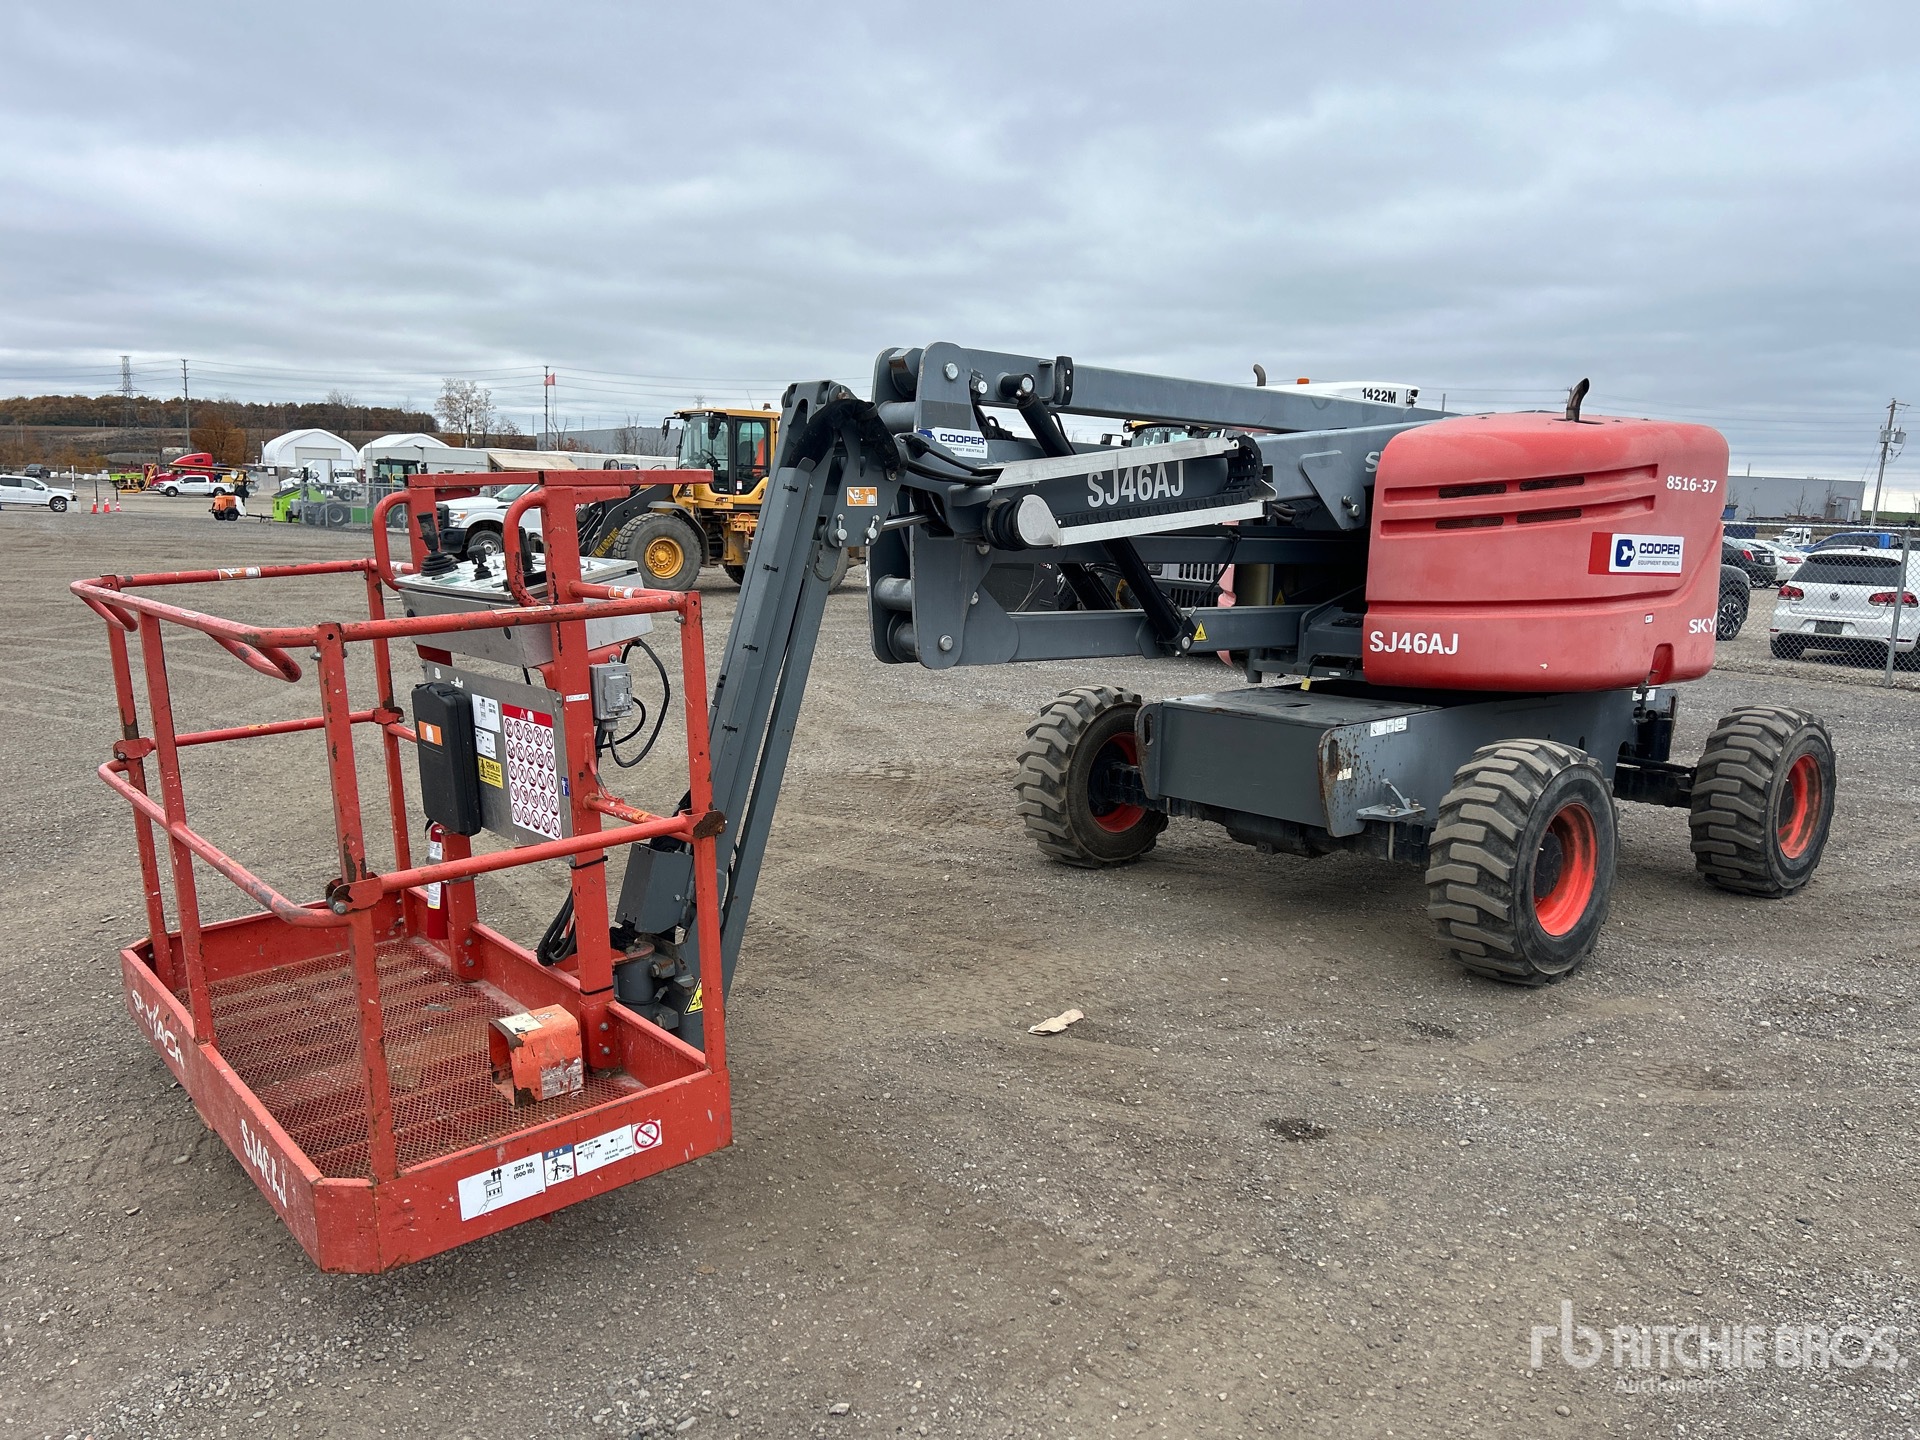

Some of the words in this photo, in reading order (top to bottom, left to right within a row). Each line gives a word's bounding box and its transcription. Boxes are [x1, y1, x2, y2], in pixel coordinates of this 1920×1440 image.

[1362, 388, 1396, 403] 1422M
[940, 433, 985, 445] COOPER
[1365, 451, 1384, 472] S
[1087, 460, 1184, 508] SJ46AJ
[1666, 475, 1717, 493] 8516-37
[1640, 543, 1680, 555] COOPER
[1369, 630, 1459, 655] SJ46AJ
[513, 1170, 527, 1180] (500
[514, 1163, 525, 1172] 227
